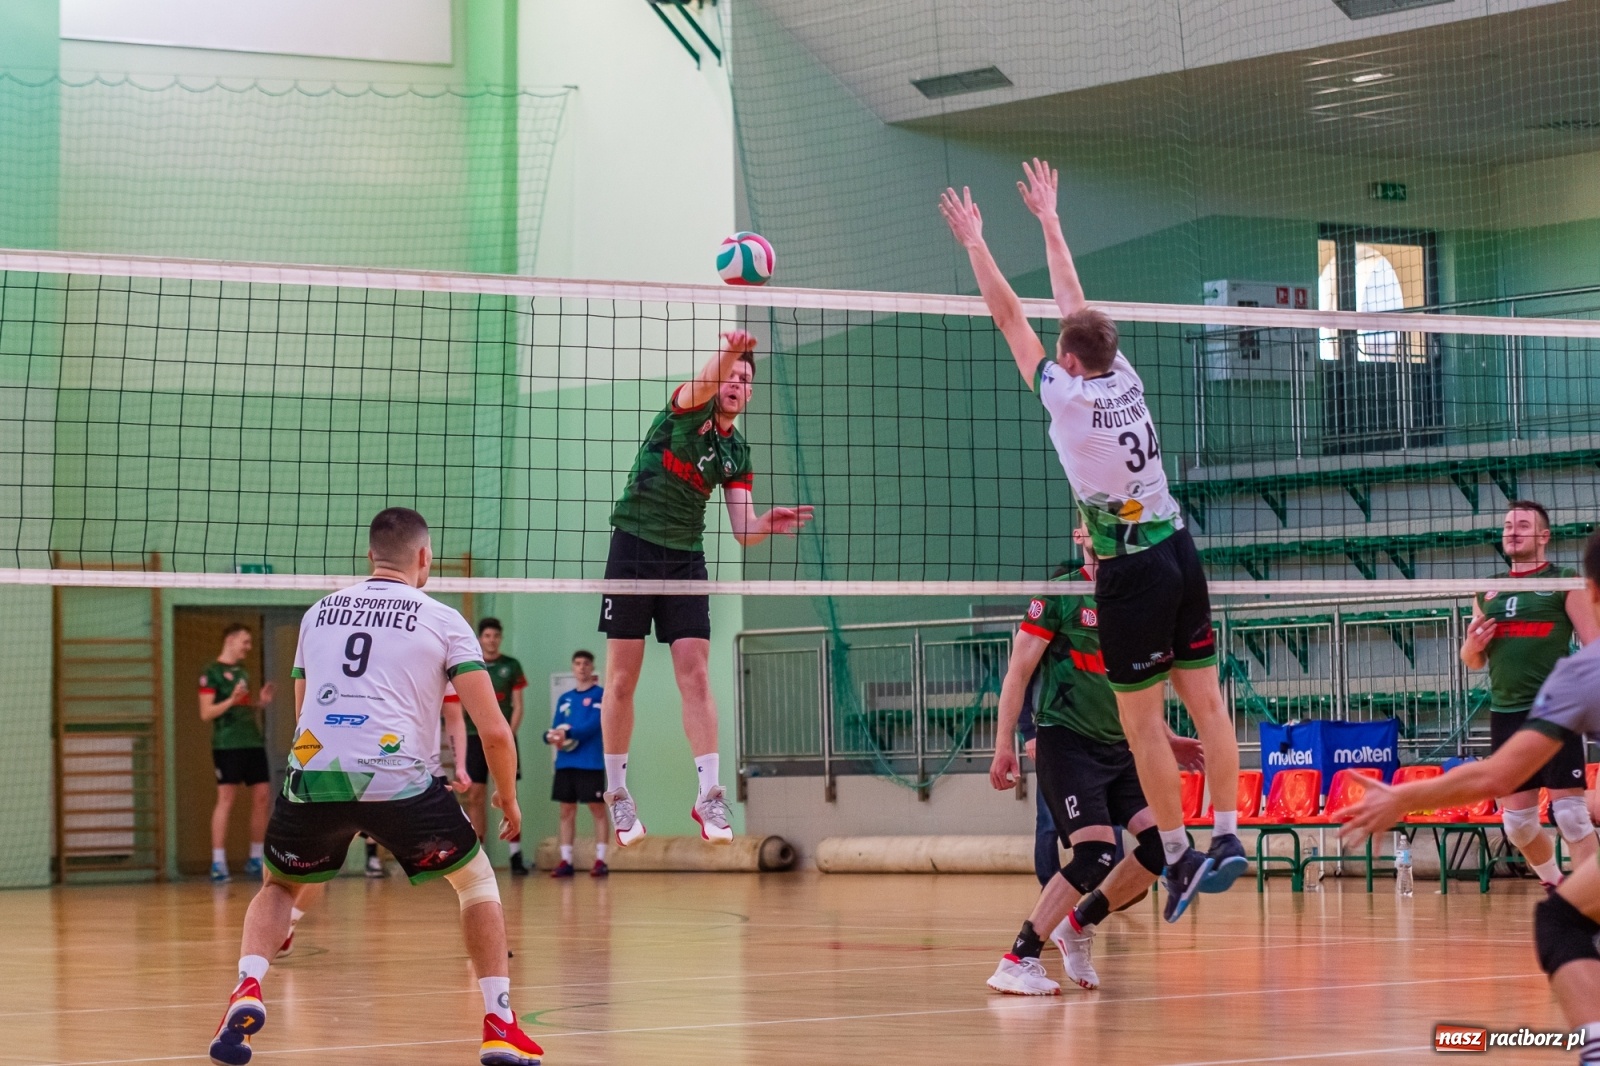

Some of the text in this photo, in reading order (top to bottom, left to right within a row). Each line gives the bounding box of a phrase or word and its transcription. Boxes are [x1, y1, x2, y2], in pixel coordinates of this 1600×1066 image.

[1118, 421, 1160, 473] 34
[319, 595, 423, 614] KLUB SPORTOWY
[604, 598, 613, 621] 2
[1505, 596, 1518, 618] 9
[315, 608, 418, 632] RUDZINIEC
[342, 632, 373, 678] 9
[357, 758, 402, 766] RUDZINIEC
[1268, 746, 1393, 766] molten molten
[1064, 794, 1081, 820] 12
